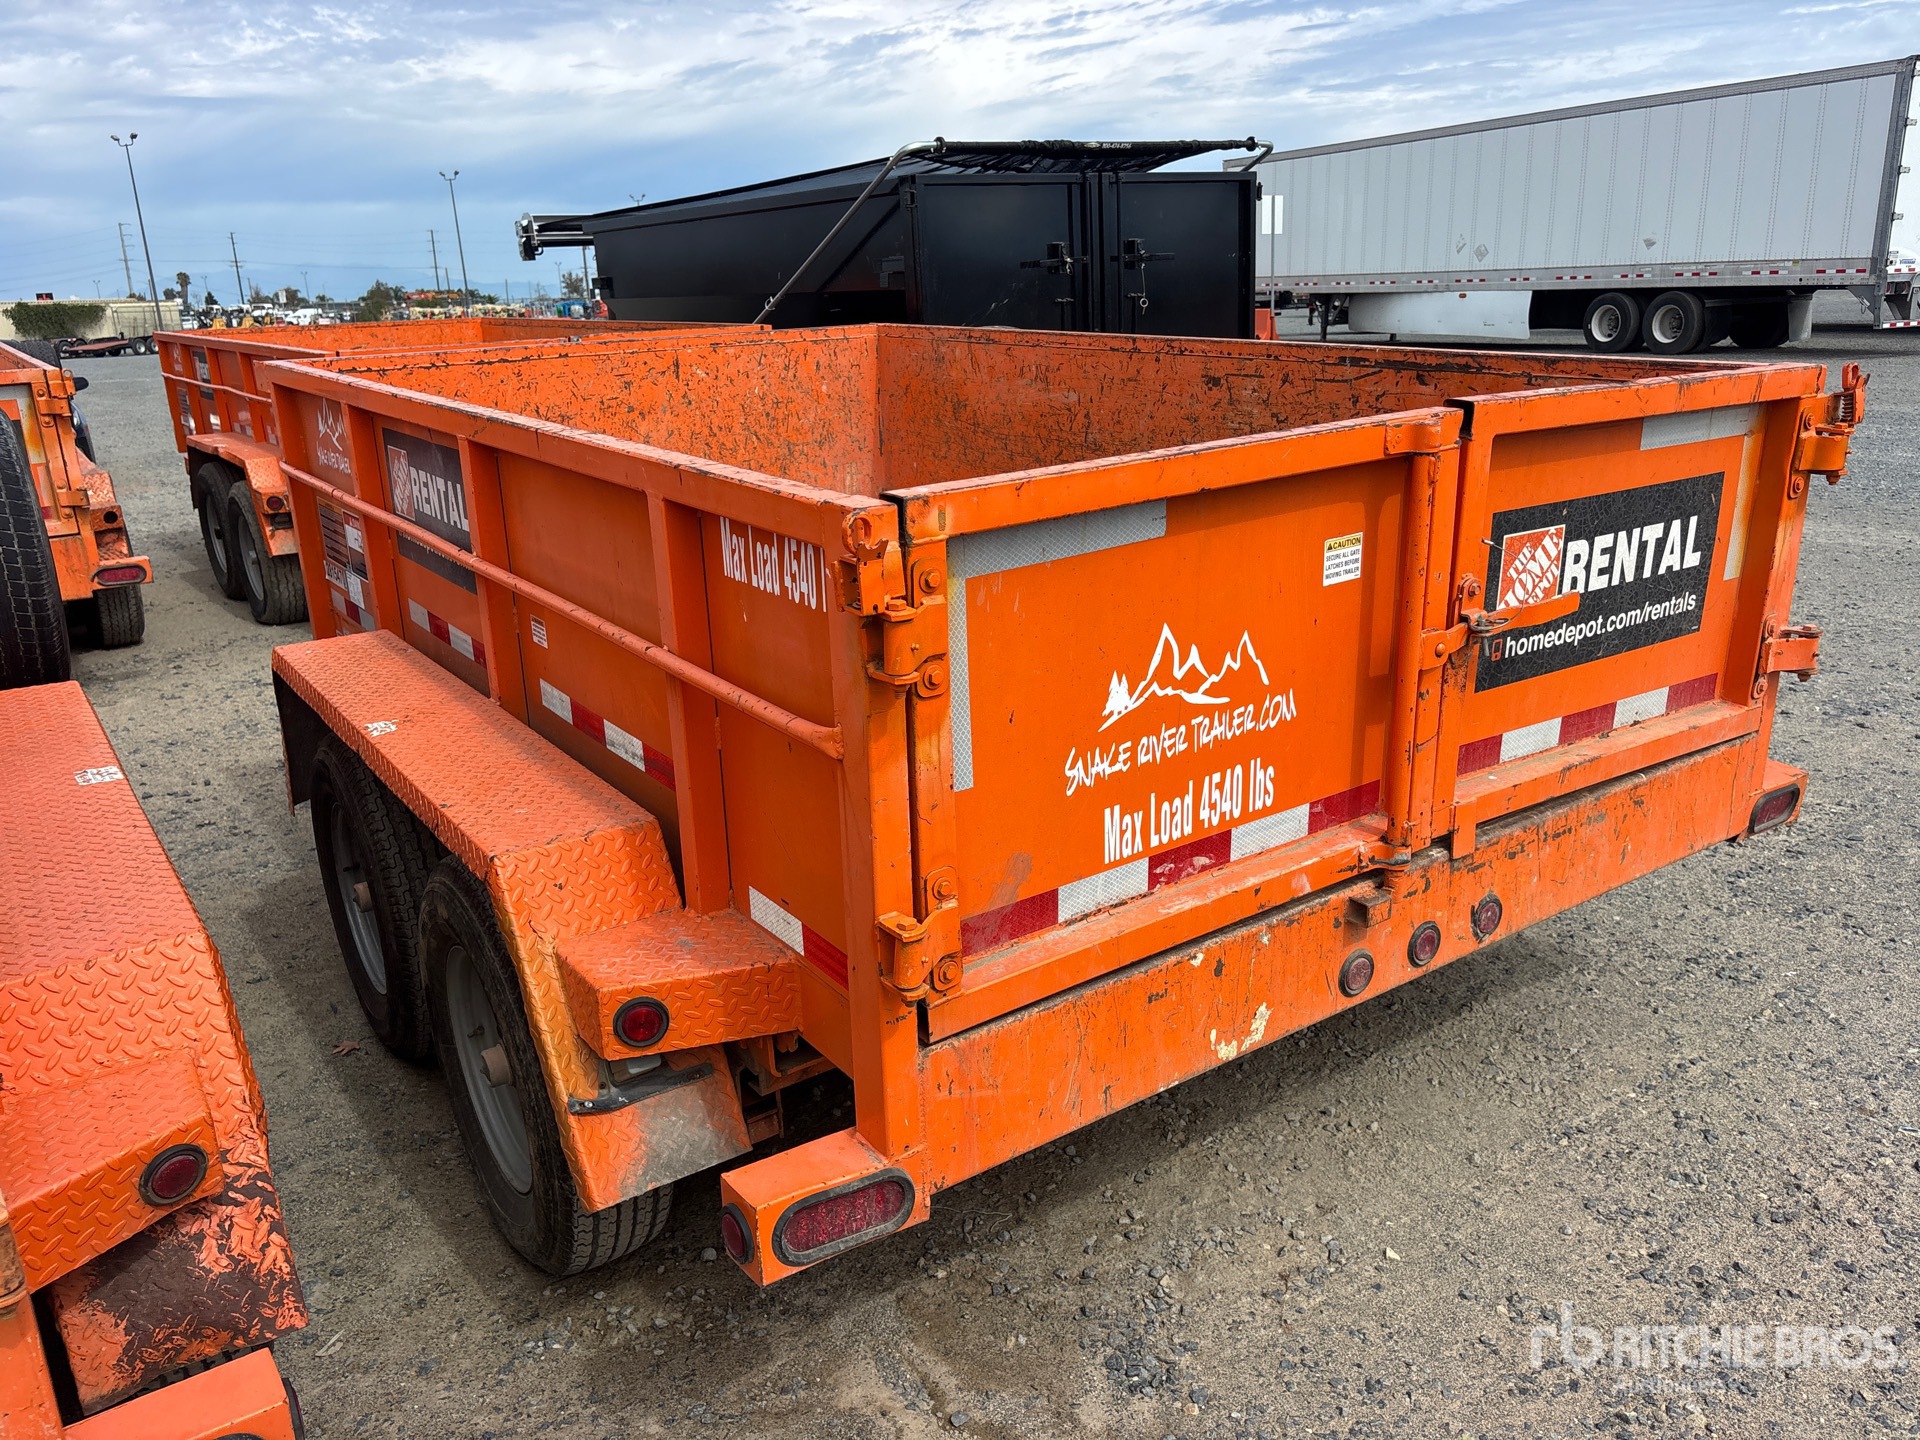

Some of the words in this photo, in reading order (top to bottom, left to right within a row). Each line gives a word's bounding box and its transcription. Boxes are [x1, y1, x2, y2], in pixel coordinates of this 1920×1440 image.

[409, 465, 470, 532] RENTAL
[720, 515, 748, 584] Max
[748, 524, 781, 596] Load
[784, 536, 817, 610] 4540
[1325, 561, 1344, 571] LATCHES
[1344, 557, 1360, 567] BEFORE
[1325, 571, 1341, 580] MOVING
[1343, 567, 1359, 575] TRAILER
[1326, 553, 1341, 562] SECURE
[1333, 537, 1361, 549] CAUTION
[1507, 542, 1535, 580] THE
[1562, 515, 1701, 594] RENTAL
[1504, 592, 1697, 659] homedepot.com/rentals
[1064, 741, 1132, 797] SNAKE
[1137, 723, 1188, 767] RIVER
[1191, 688, 1297, 753] TRAILER.COM
[1104, 804, 1144, 864] Max
[1150, 779, 1194, 848] Load
[1200, 764, 1243, 829] 4540
[1249, 757, 1275, 813] lbs
